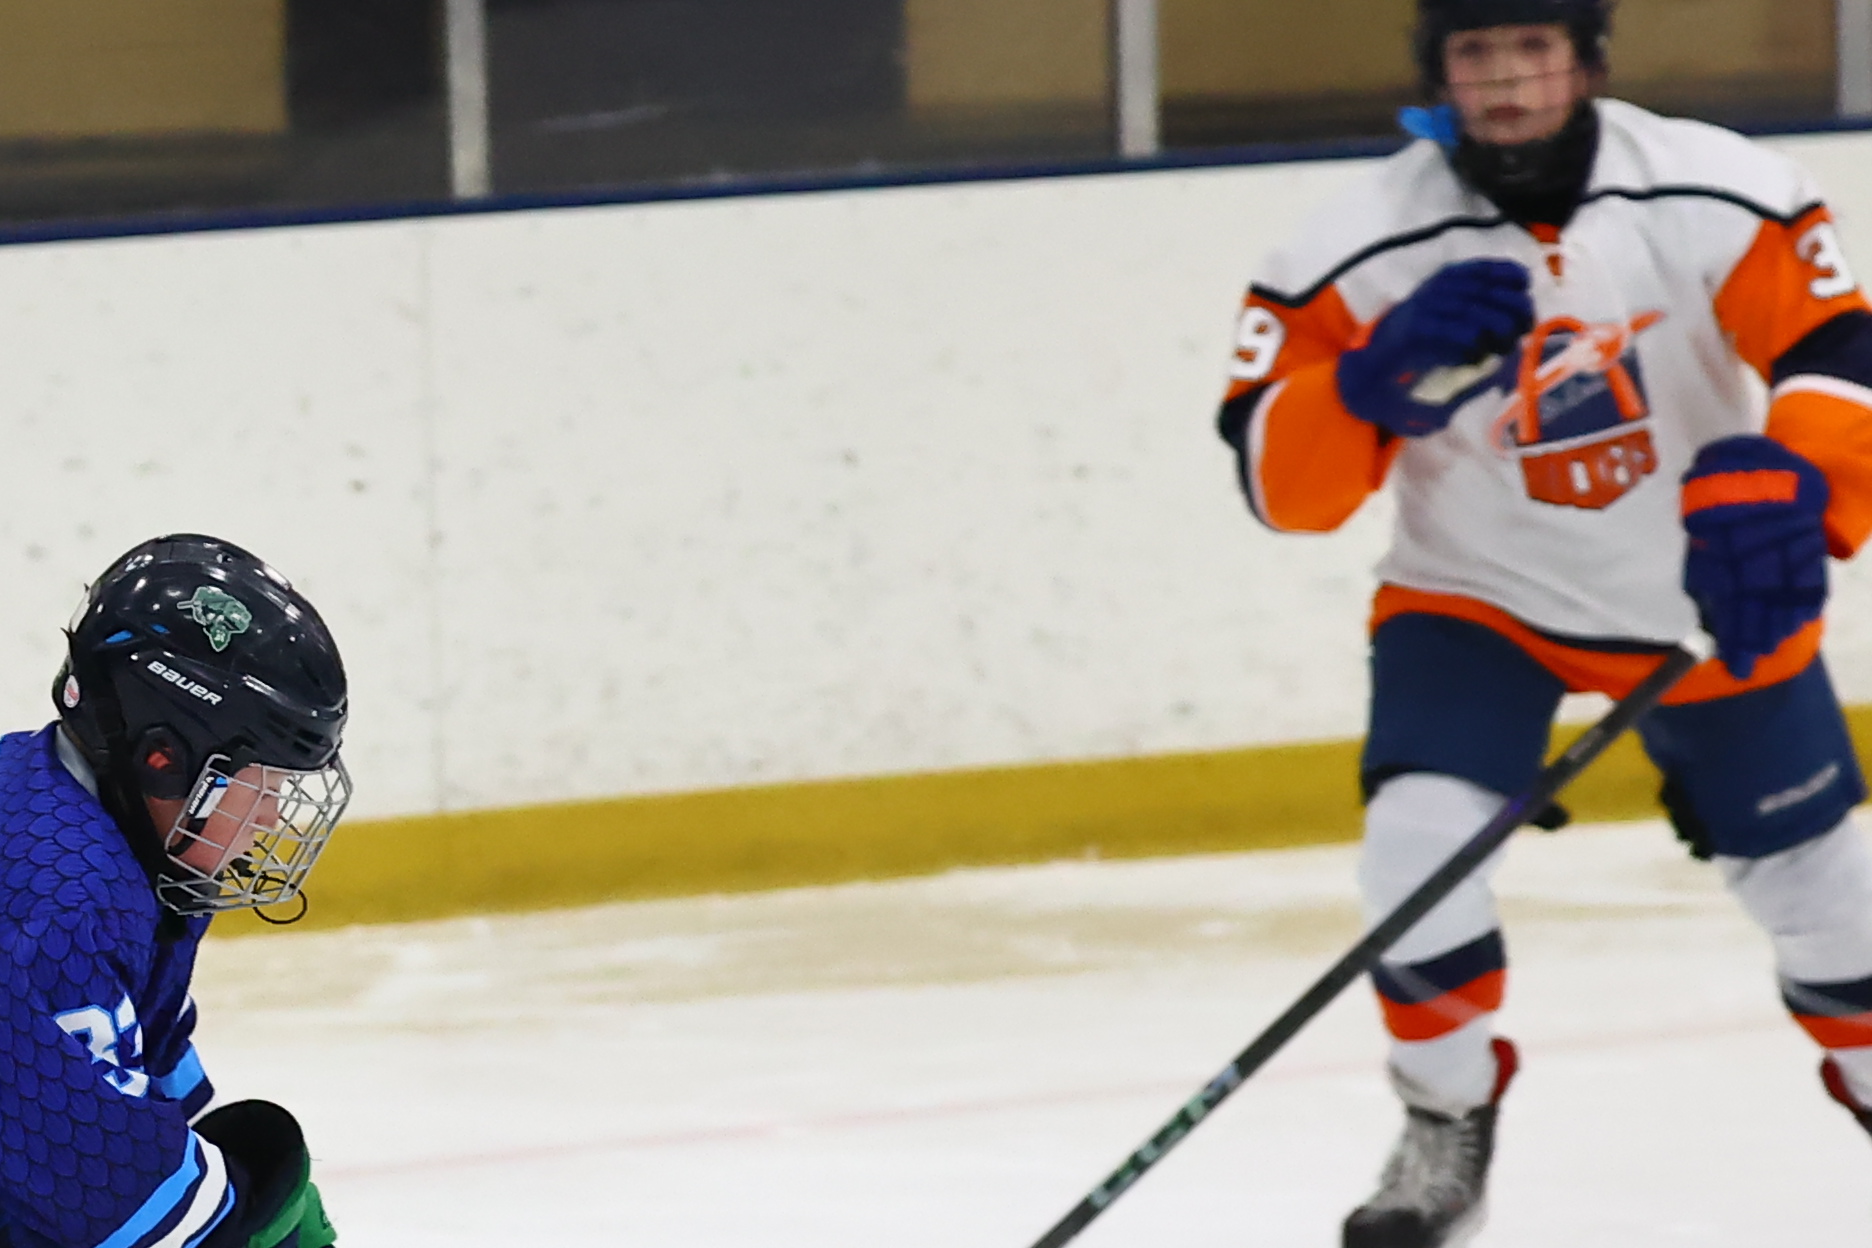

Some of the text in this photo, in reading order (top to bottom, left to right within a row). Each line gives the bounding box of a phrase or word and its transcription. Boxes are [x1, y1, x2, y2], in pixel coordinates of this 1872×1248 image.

[1795, 222, 1856, 300] 3
[1229, 306, 1287, 380] 9
[147, 660, 223, 706] BAUER
